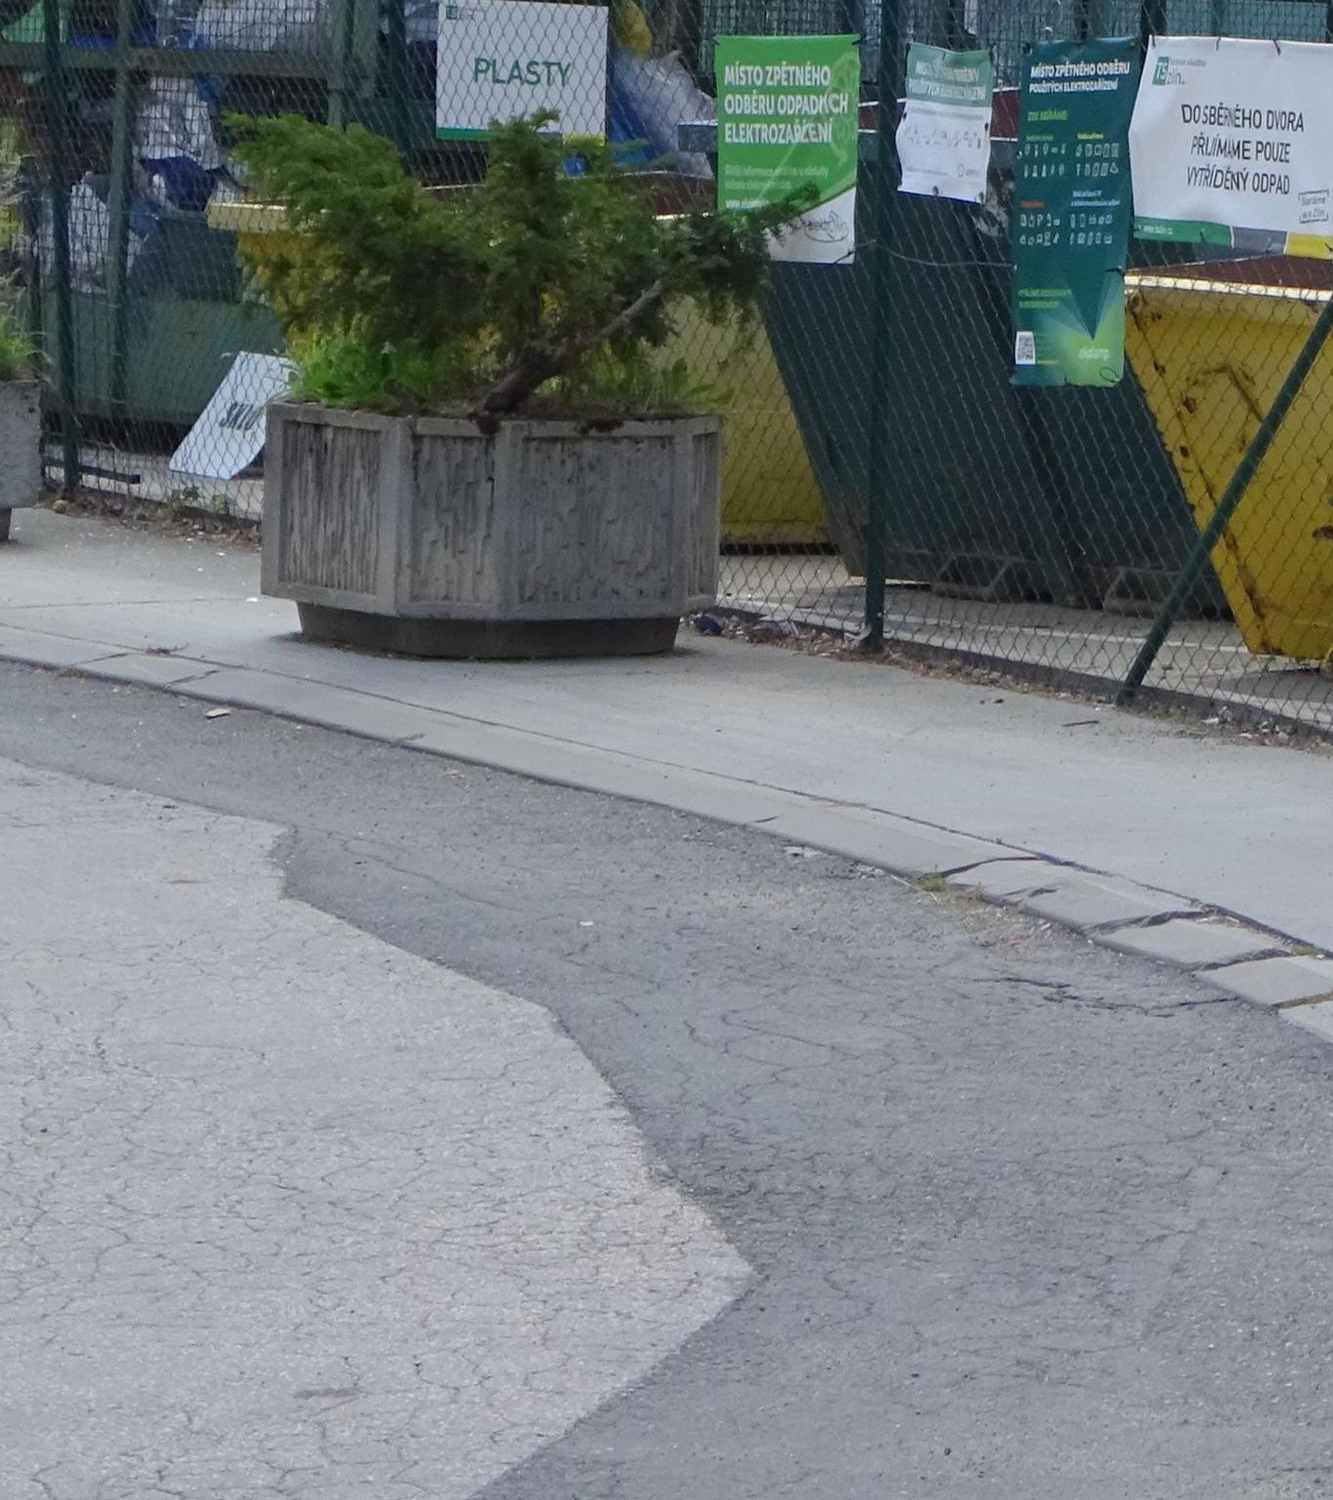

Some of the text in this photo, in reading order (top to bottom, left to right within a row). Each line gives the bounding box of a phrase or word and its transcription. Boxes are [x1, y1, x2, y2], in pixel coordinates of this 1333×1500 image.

[473, 57, 571, 88] PLASTY
[725, 60, 831, 87] MÍSTO ZPĚTNÉHO
[1030, 58, 1130, 78] MÍSTO ZPĚTNÉHO ODBĚRU
[725, 89, 774, 115] ODBĚRU
[1181, 102, 1305, 132] DO SBĚRNÉHO DVORA
[1256, 140, 1291, 164] POUZE
[1252, 171, 1291, 195] ODPAD
